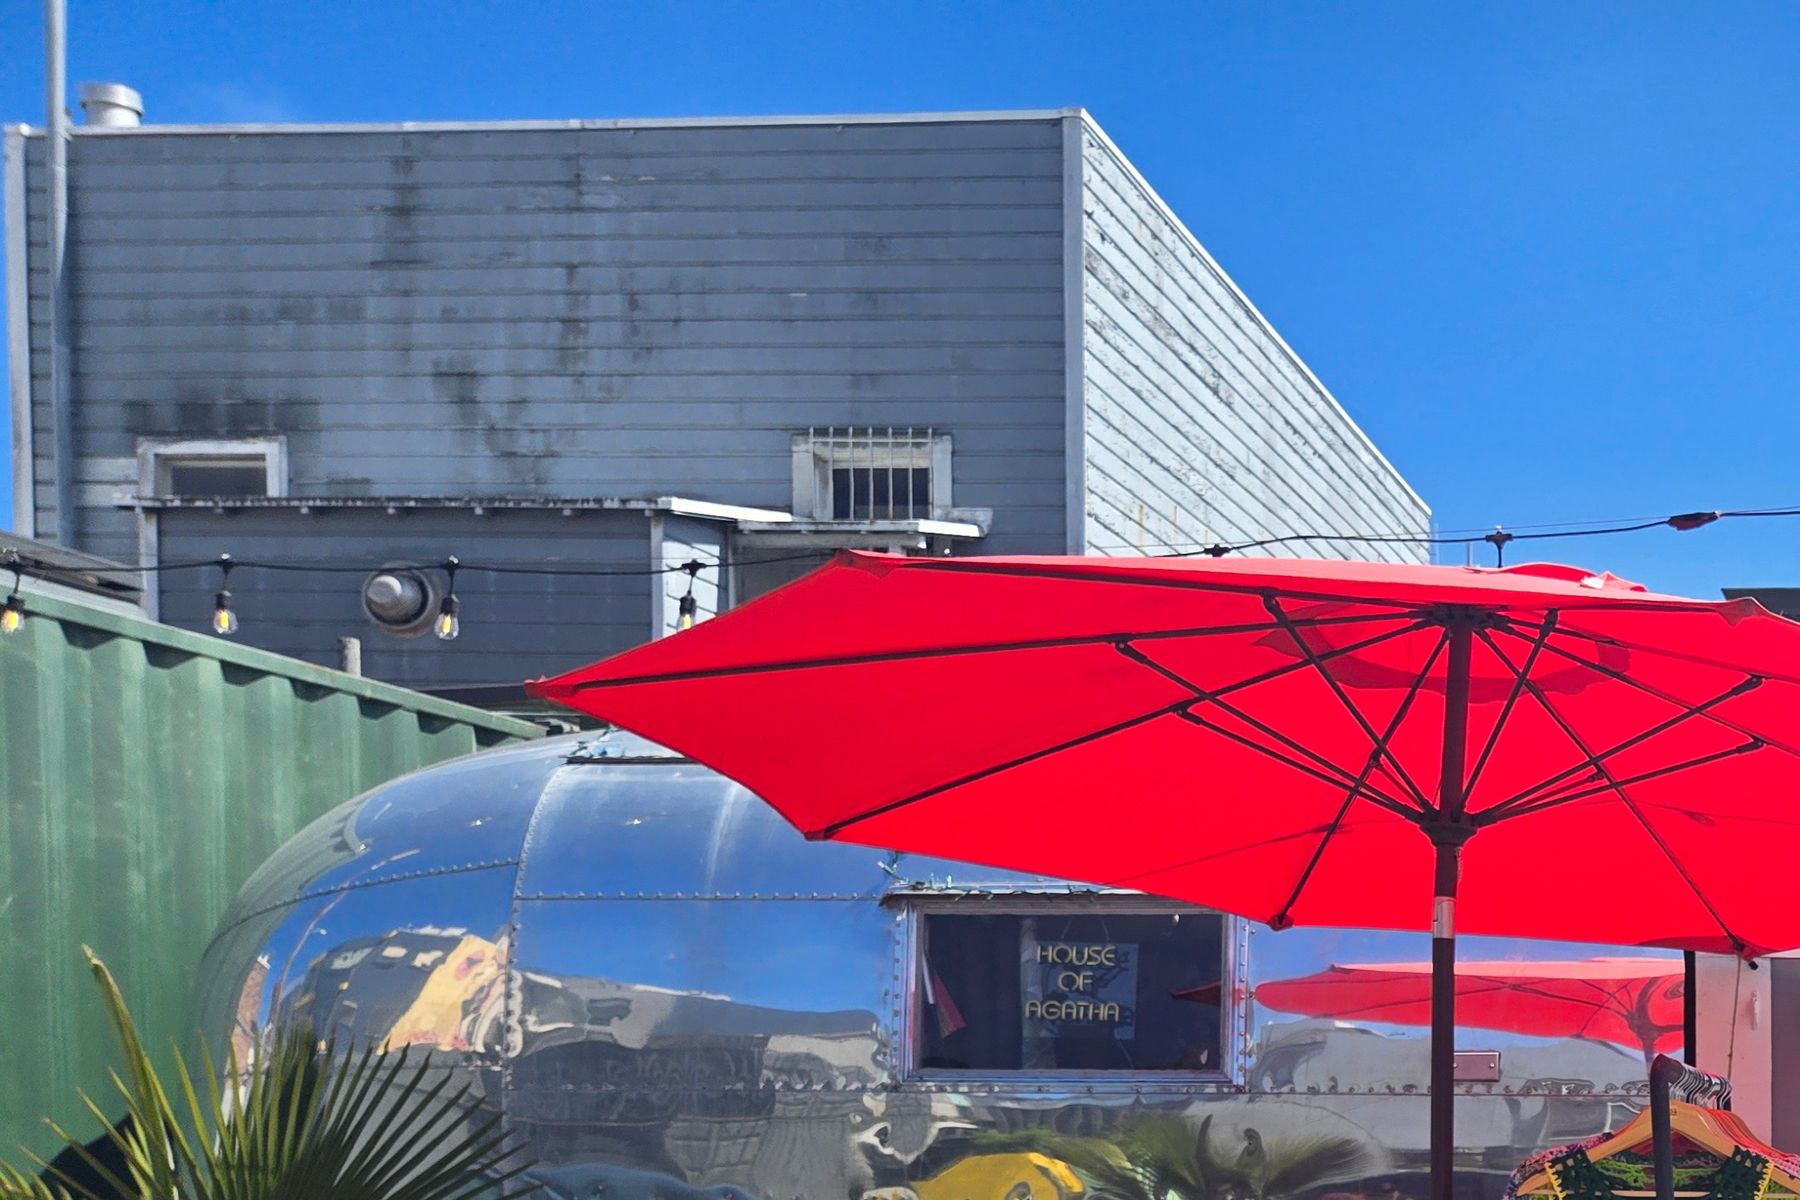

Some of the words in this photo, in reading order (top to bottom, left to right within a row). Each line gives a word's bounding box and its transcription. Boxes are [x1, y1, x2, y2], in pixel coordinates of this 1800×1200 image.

[1036, 944, 1116, 966] HOUSE
[1057, 971, 1094, 991] OF
[1024, 1000, 1120, 1022] AGATHA
